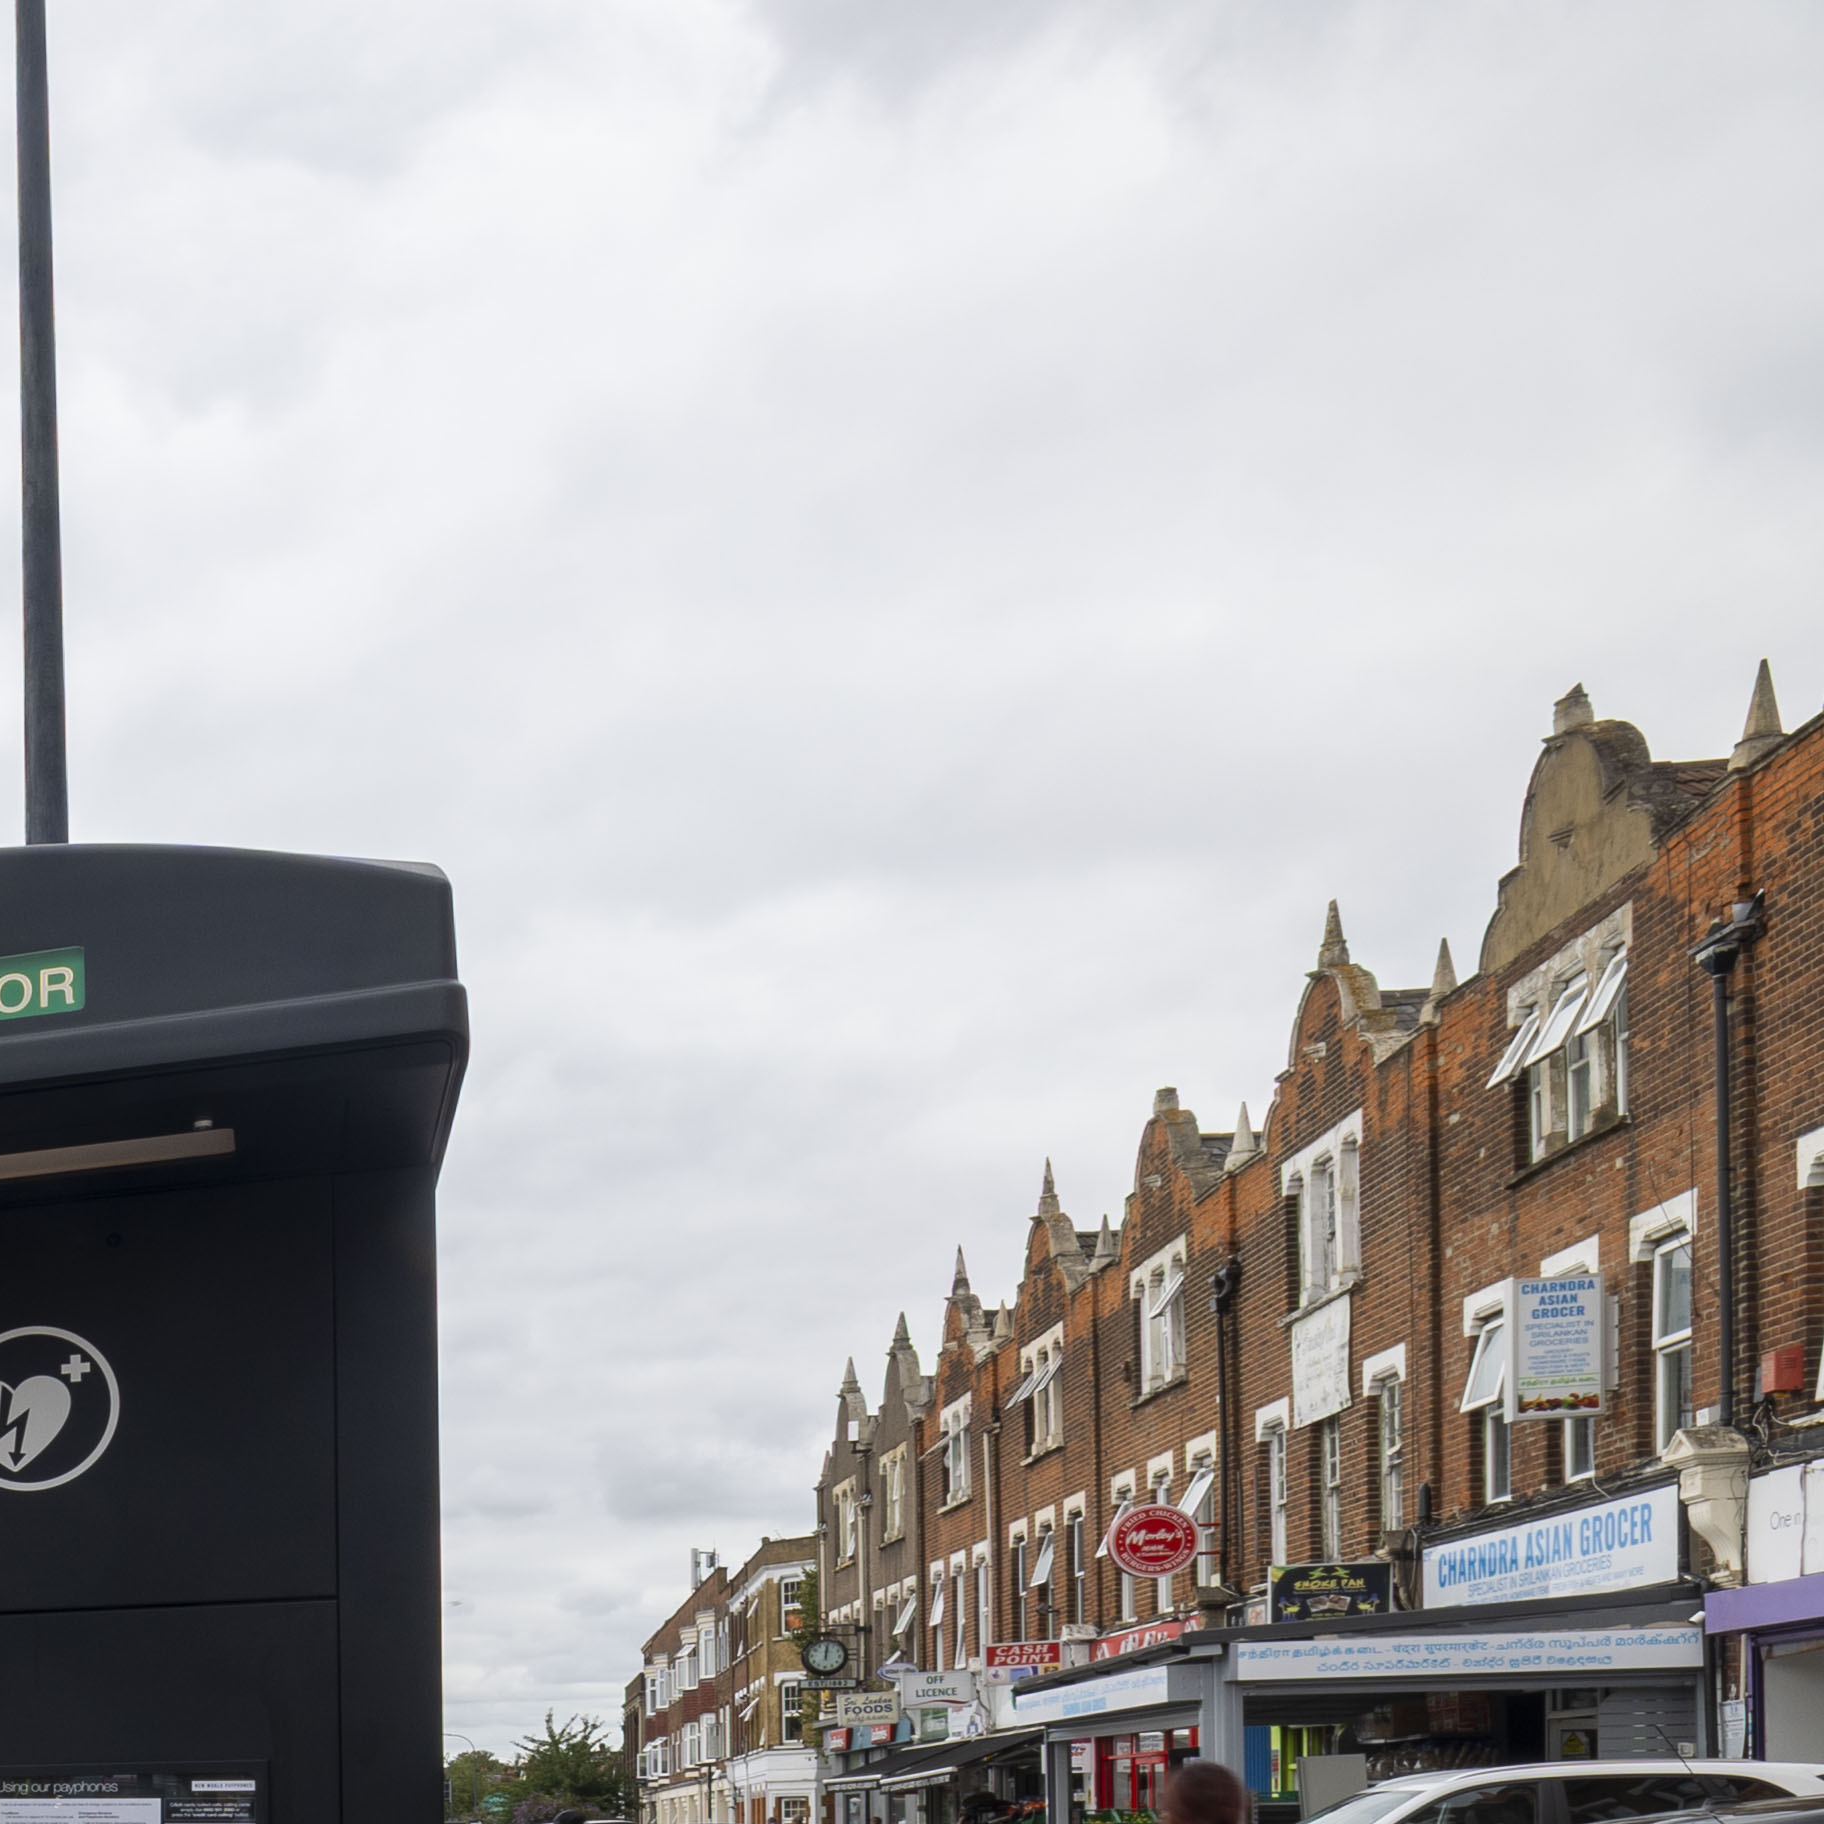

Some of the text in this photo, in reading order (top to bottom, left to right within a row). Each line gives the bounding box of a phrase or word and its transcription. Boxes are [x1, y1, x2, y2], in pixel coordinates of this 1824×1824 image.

[1521, 1280, 1595, 1295] CHARNDRA
[1538, 1293, 1578, 1306] ASIAN
[1532, 1305, 1585, 1319] GROCER
[1525, 1320, 1581, 1331] SPECIALIST
[1529, 1337, 1589, 1347] GROCERIES
[1121, 1509, 1189, 1532] FRIED CHICKEN
[1770, 1511, 1792, 1530] One
[1126, 1528, 1183, 1546] Morley's
[1438, 1503, 1653, 1588] CHARNDRA ASIAN GROCER
[1468, 1554, 1612, 1598] SPECIALIST IN SRILANKAN GROCERIES
[1294, 1579, 1338, 1591] SMOKE
[1341, 1578, 1366, 1589] PAN
[997, 1644, 1050, 1656] CASH
[993, 1652, 1054, 1666] POINT
[926, 1675, 945, 1685] OFF
[916, 1687, 958, 1698] LICENCE
[844, 1703, 893, 1715] FOODS
[31, 1783, 51, 1793] our
[53, 1781, 119, 1796] payphones
